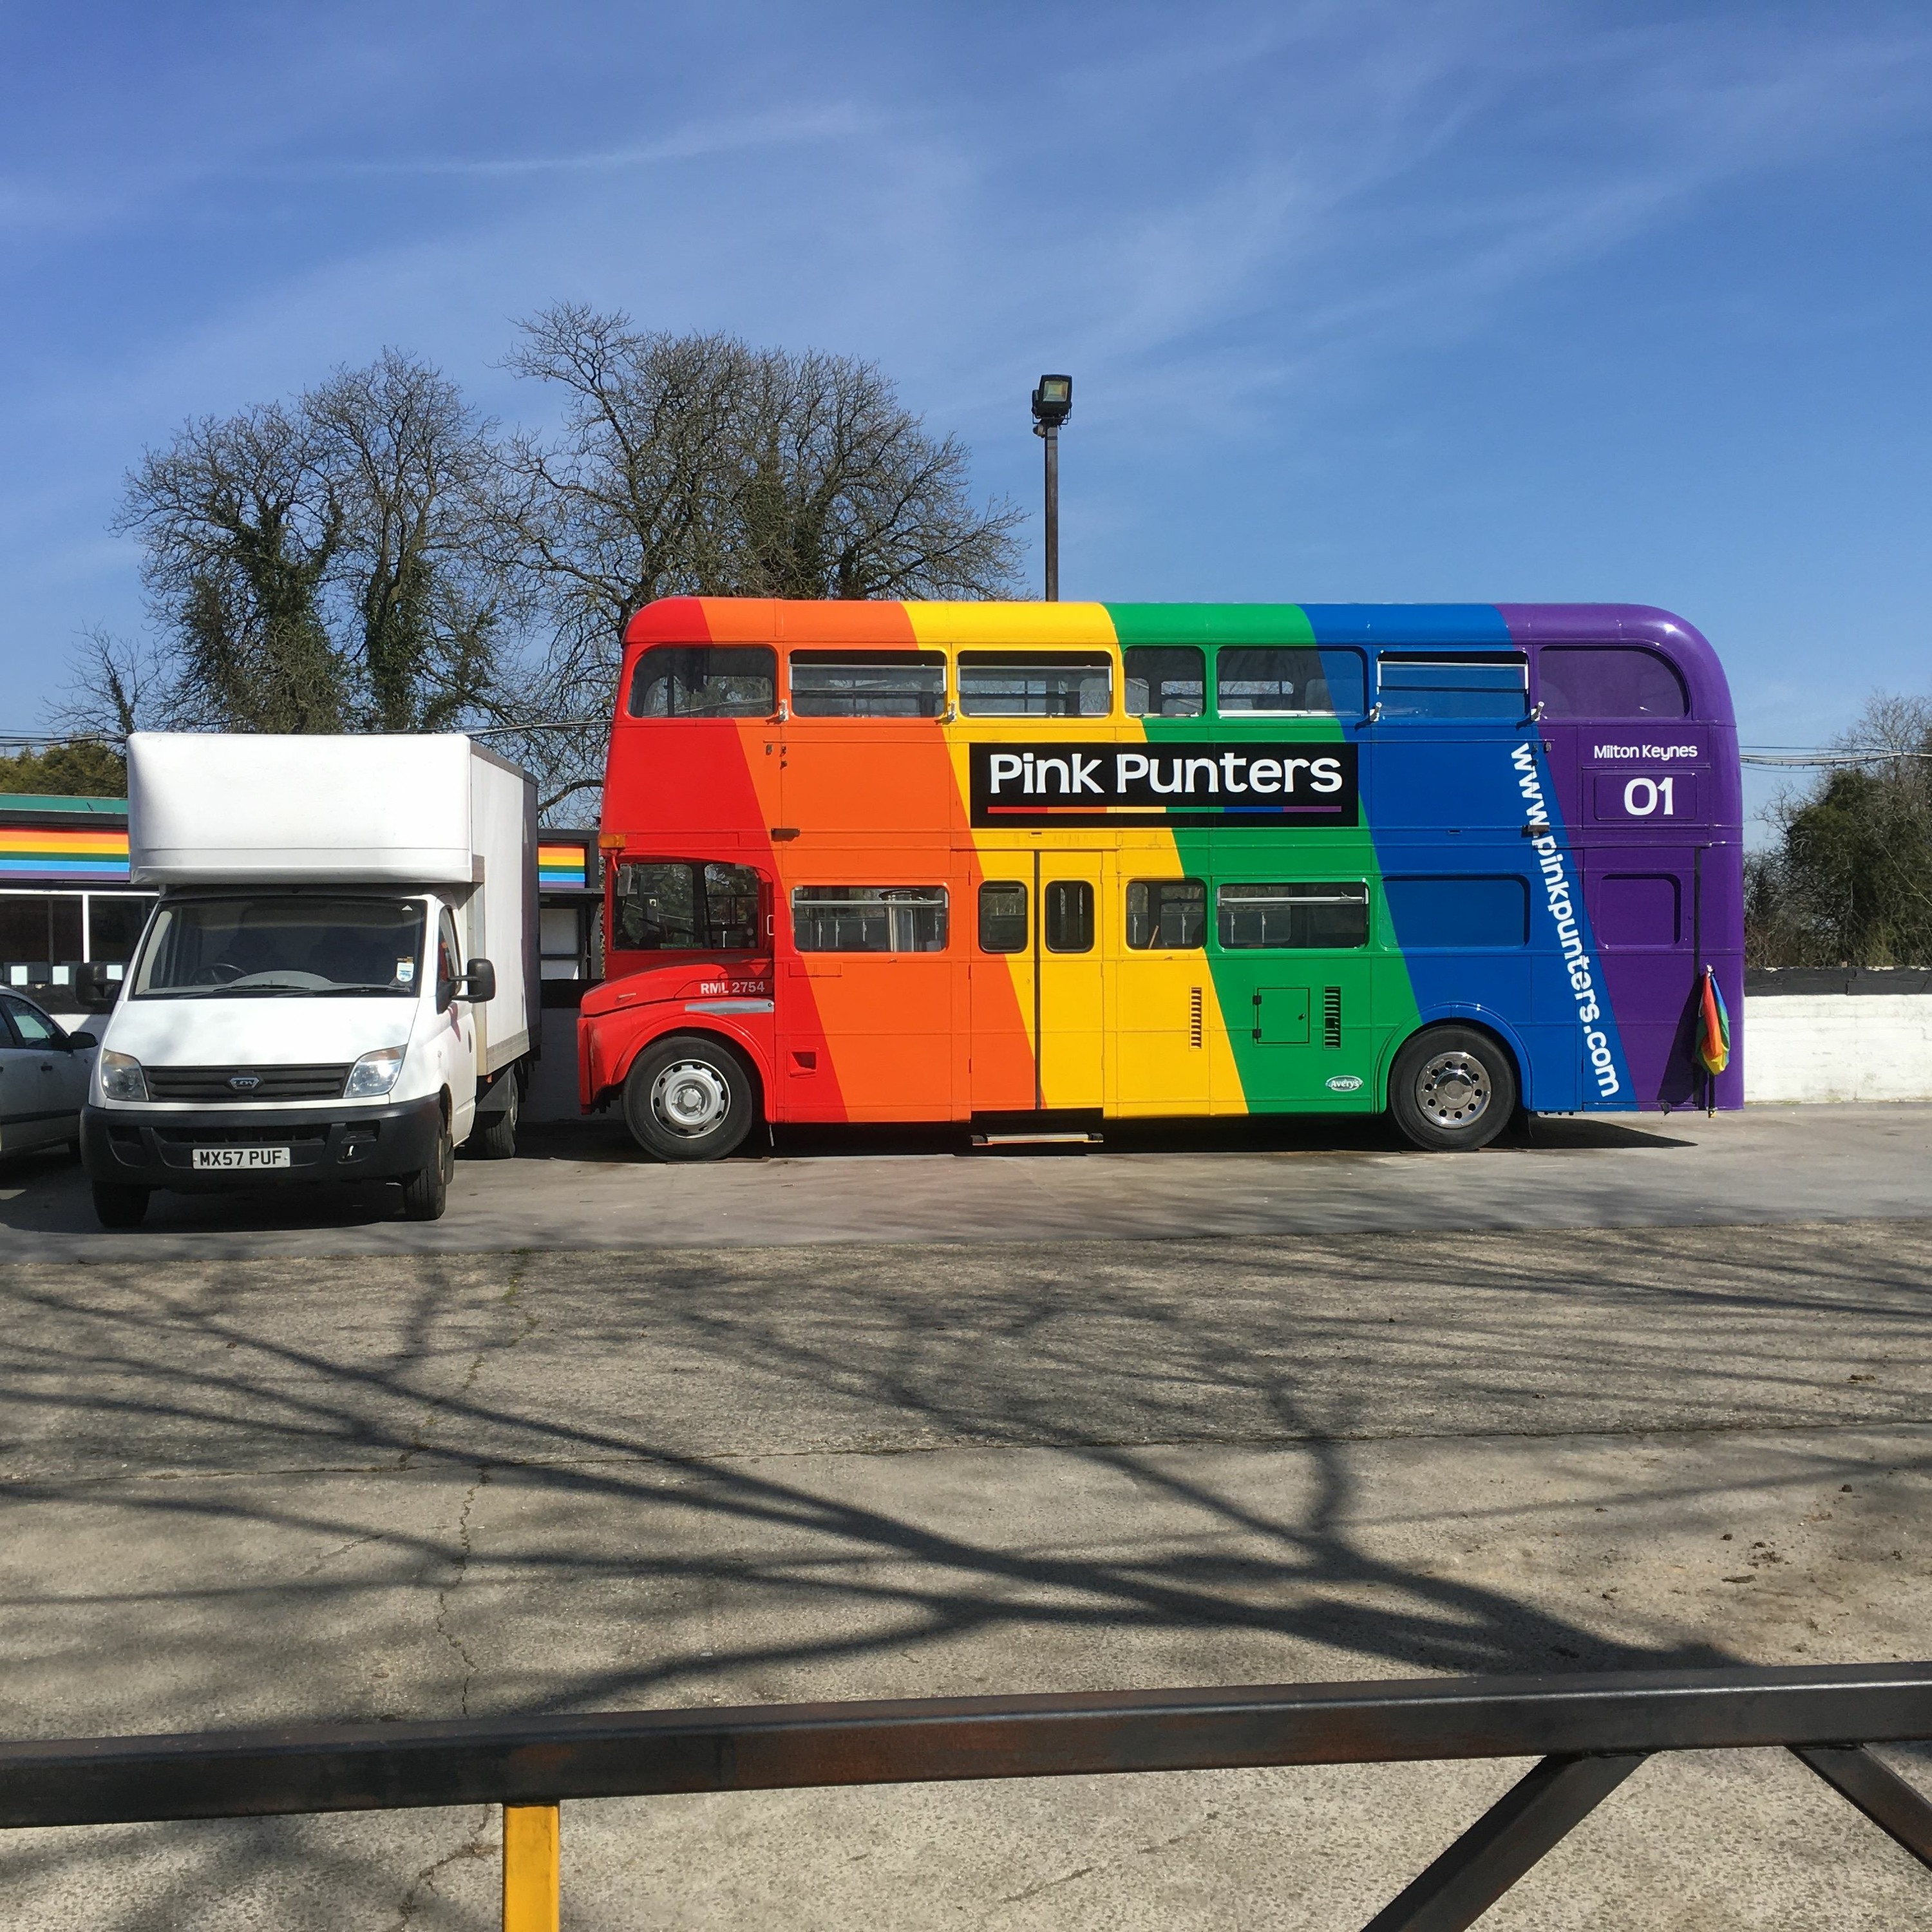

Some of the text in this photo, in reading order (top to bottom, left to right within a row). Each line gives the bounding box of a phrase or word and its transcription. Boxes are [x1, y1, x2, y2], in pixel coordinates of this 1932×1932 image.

[1594, 744, 1698, 761] Milton Keynes
[989, 752, 1343, 794] Pink Punters
[1624, 777, 1674, 816] 01
[1511, 743, 1620, 1097] www.pinkpunters.com
[700, 981, 765, 994] RML 2754
[200, 1150, 282, 1166] MX57 PUF
